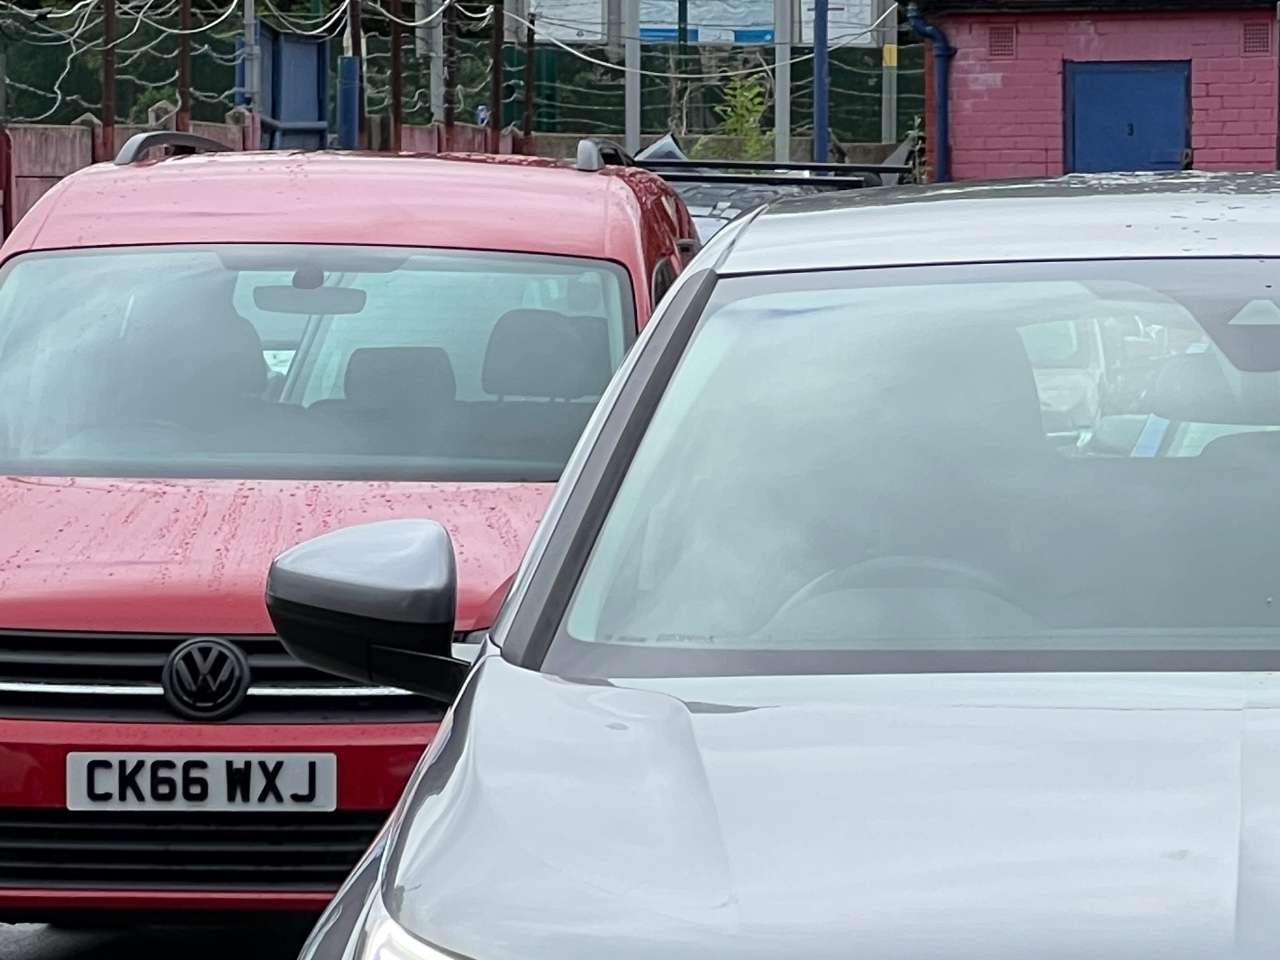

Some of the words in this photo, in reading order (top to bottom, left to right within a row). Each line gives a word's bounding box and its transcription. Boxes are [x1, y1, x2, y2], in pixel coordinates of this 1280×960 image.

[1127, 122, 1135, 137] 3
[86, 759, 209, 803] CK66
[225, 759, 317, 803] WXJ
